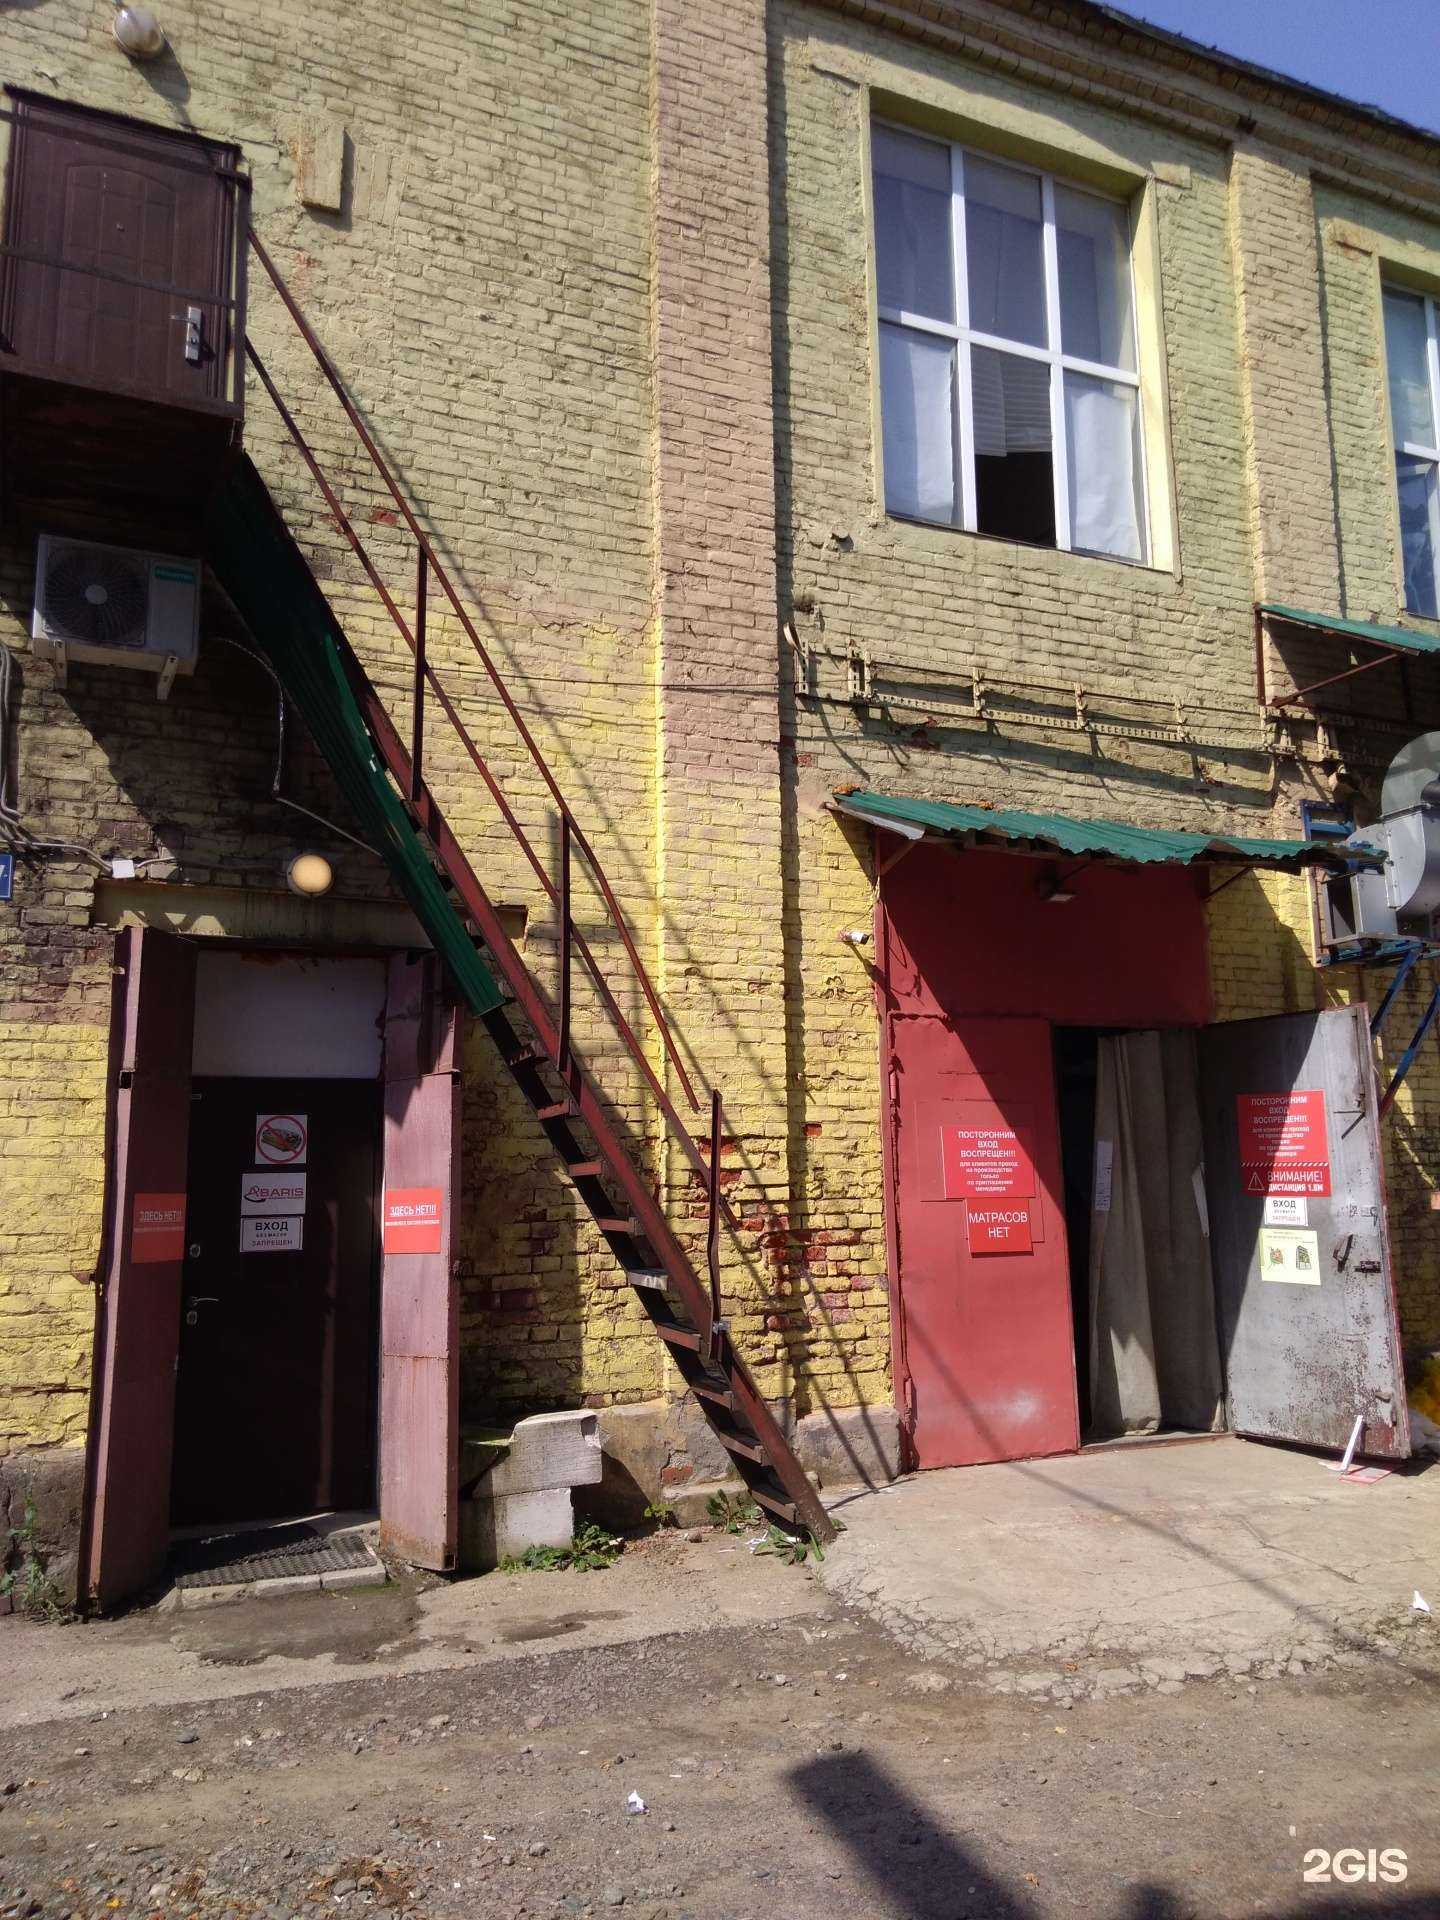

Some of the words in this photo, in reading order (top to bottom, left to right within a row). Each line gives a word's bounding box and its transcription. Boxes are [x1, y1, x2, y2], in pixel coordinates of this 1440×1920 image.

[1252, 1096, 1308, 1106] ПОСТОРОННИМ
[1268, 1106, 1290, 1115] ВХОД
[958, 1131, 1016, 1139] ПОСТОРОННИМ
[960, 1150, 1016, 1158] ВОСПРЕЩЕН!!!
[1268, 1170, 1322, 1182] ВНИМАНИЕ!
[248, 1186, 304, 1198] ABARIS
[1268, 1184, 1306, 1192] ДИСТАНЦИЯ
[1272, 1200, 1296, 1210] ВХОД
[390, 1206, 414, 1216] ЗДЕСЬ
[139, 1210, 163, 1223] ЗДЕСЬ
[968, 1212, 1028, 1223] МАТРАСОВ
[256, 1222, 288, 1232] ВХОД
[988, 1226, 1010, 1238] НЕТ
